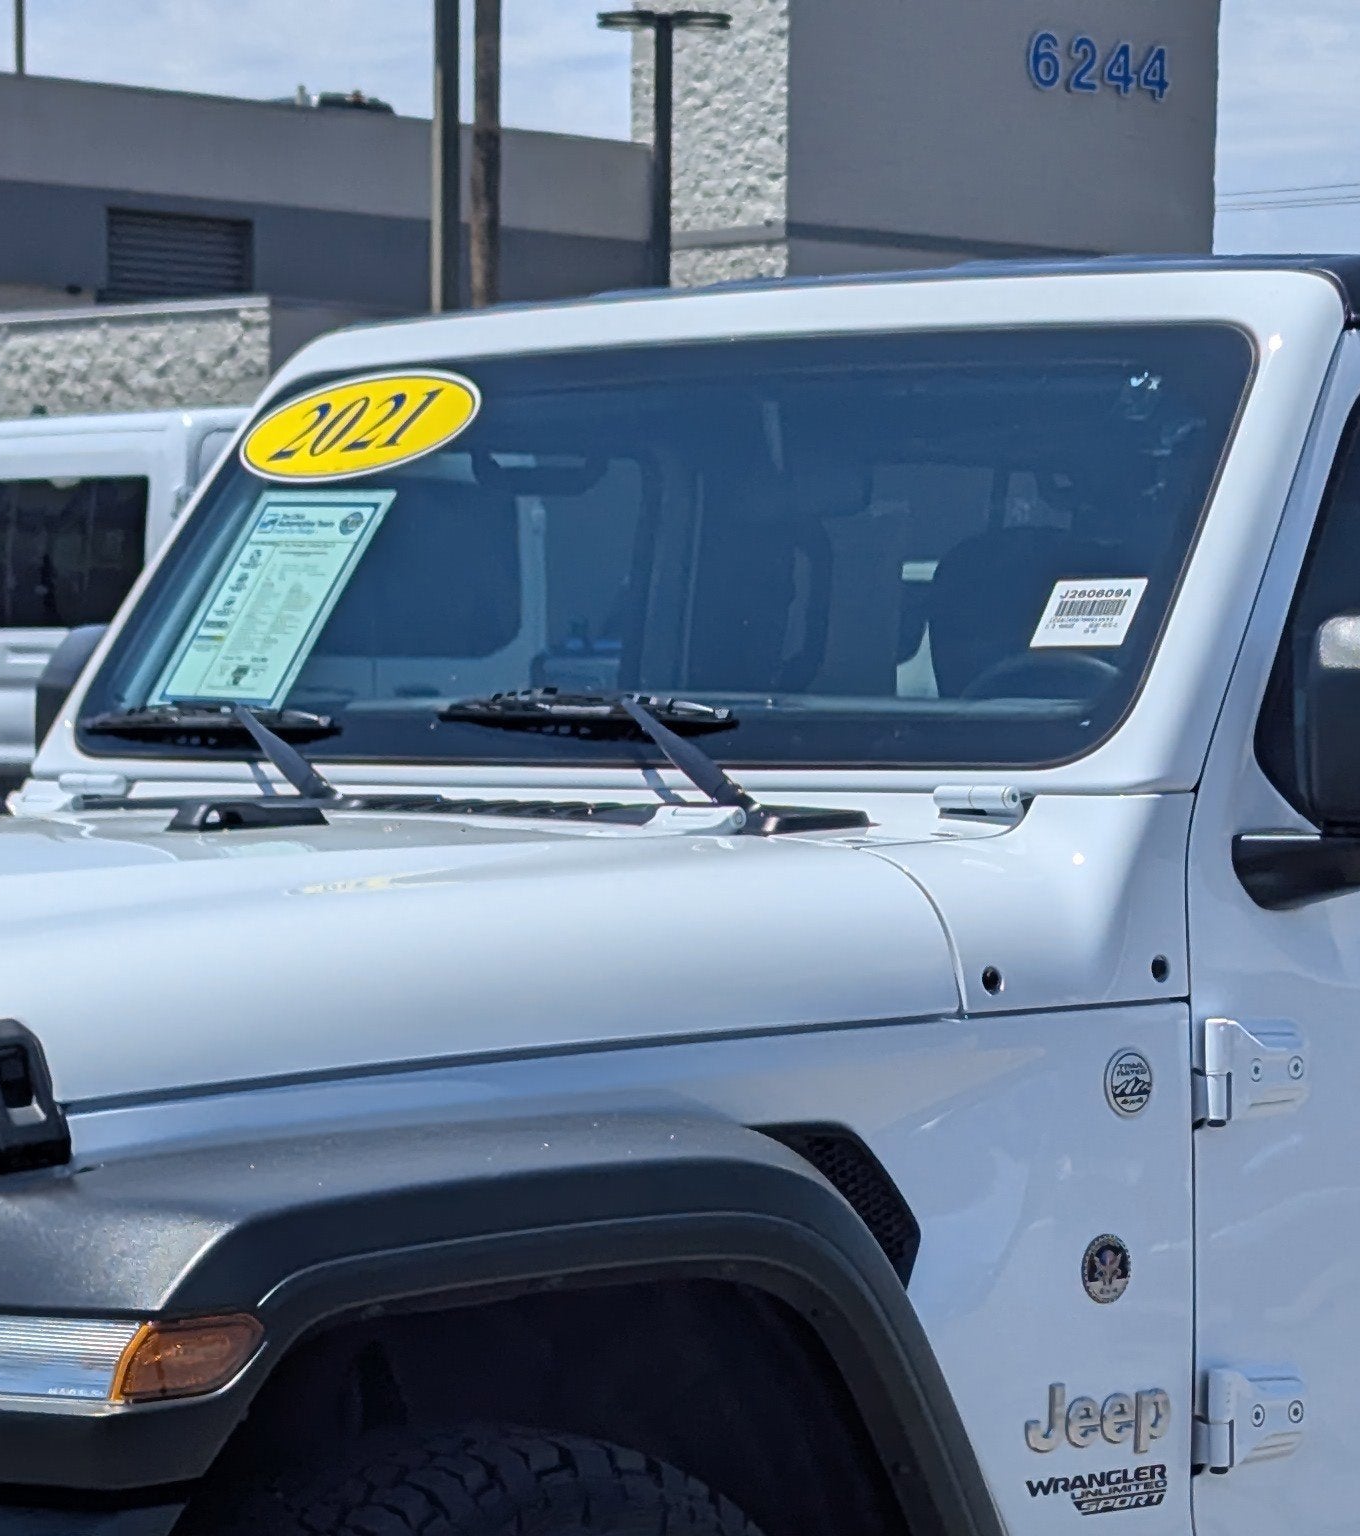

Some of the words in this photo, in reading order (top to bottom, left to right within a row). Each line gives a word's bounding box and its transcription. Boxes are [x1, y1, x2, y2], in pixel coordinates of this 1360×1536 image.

[1028, 29, 1170, 103] 6244
[267, 388, 444, 462] 2021
[1025, 1382, 1171, 1454] Jeep
[1025, 1463, 1167, 1498] WRANGLER
[1070, 1479, 1168, 1500] UNLIMITED
[1081, 1493, 1164, 1512] SPORT
